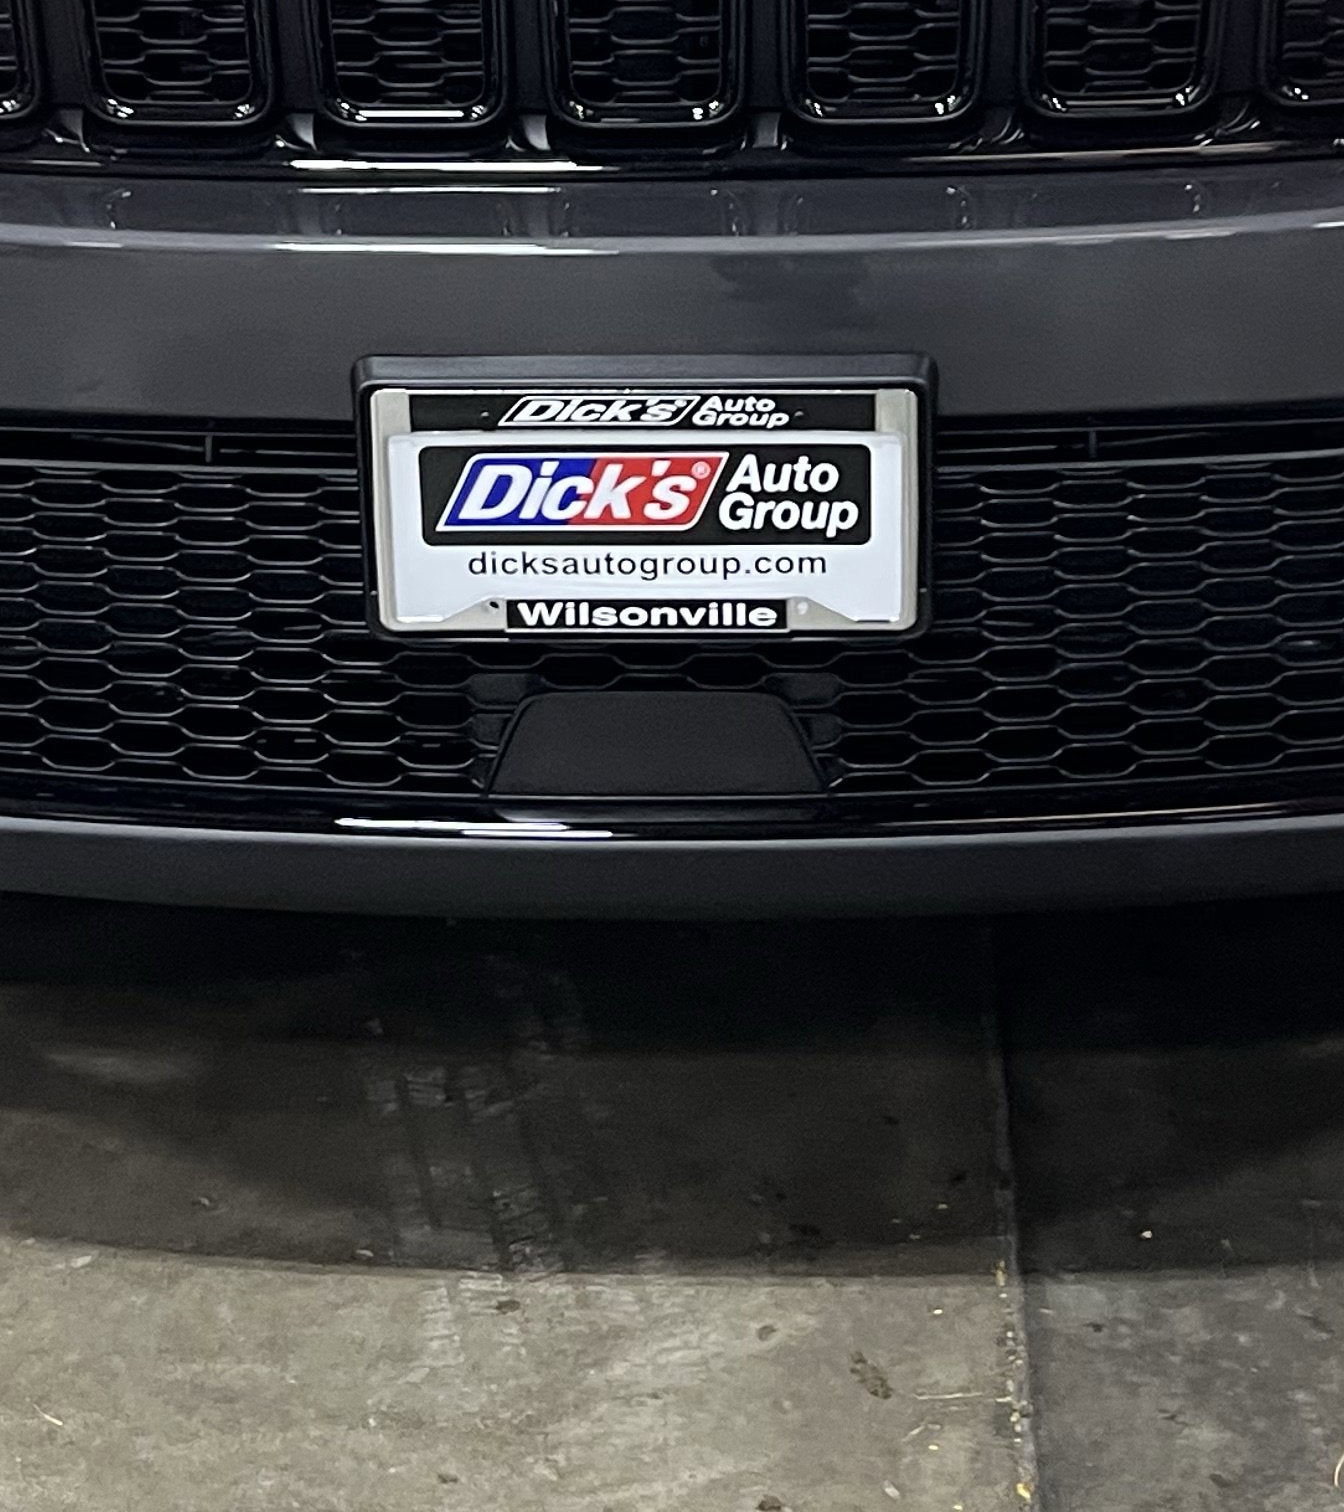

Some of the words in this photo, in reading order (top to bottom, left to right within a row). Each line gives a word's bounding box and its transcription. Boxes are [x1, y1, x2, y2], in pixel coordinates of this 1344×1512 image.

[513, 398, 679, 423] Dick's
[701, 396, 776, 412] Auto
[692, 410, 790, 429] Group
[726, 454, 840, 493] Auto
[455, 459, 698, 522] Dick's
[718, 492, 860, 538] Group
[467, 550, 828, 581] dicksautogroup.com
[516, 600, 779, 628] Wilsonville
